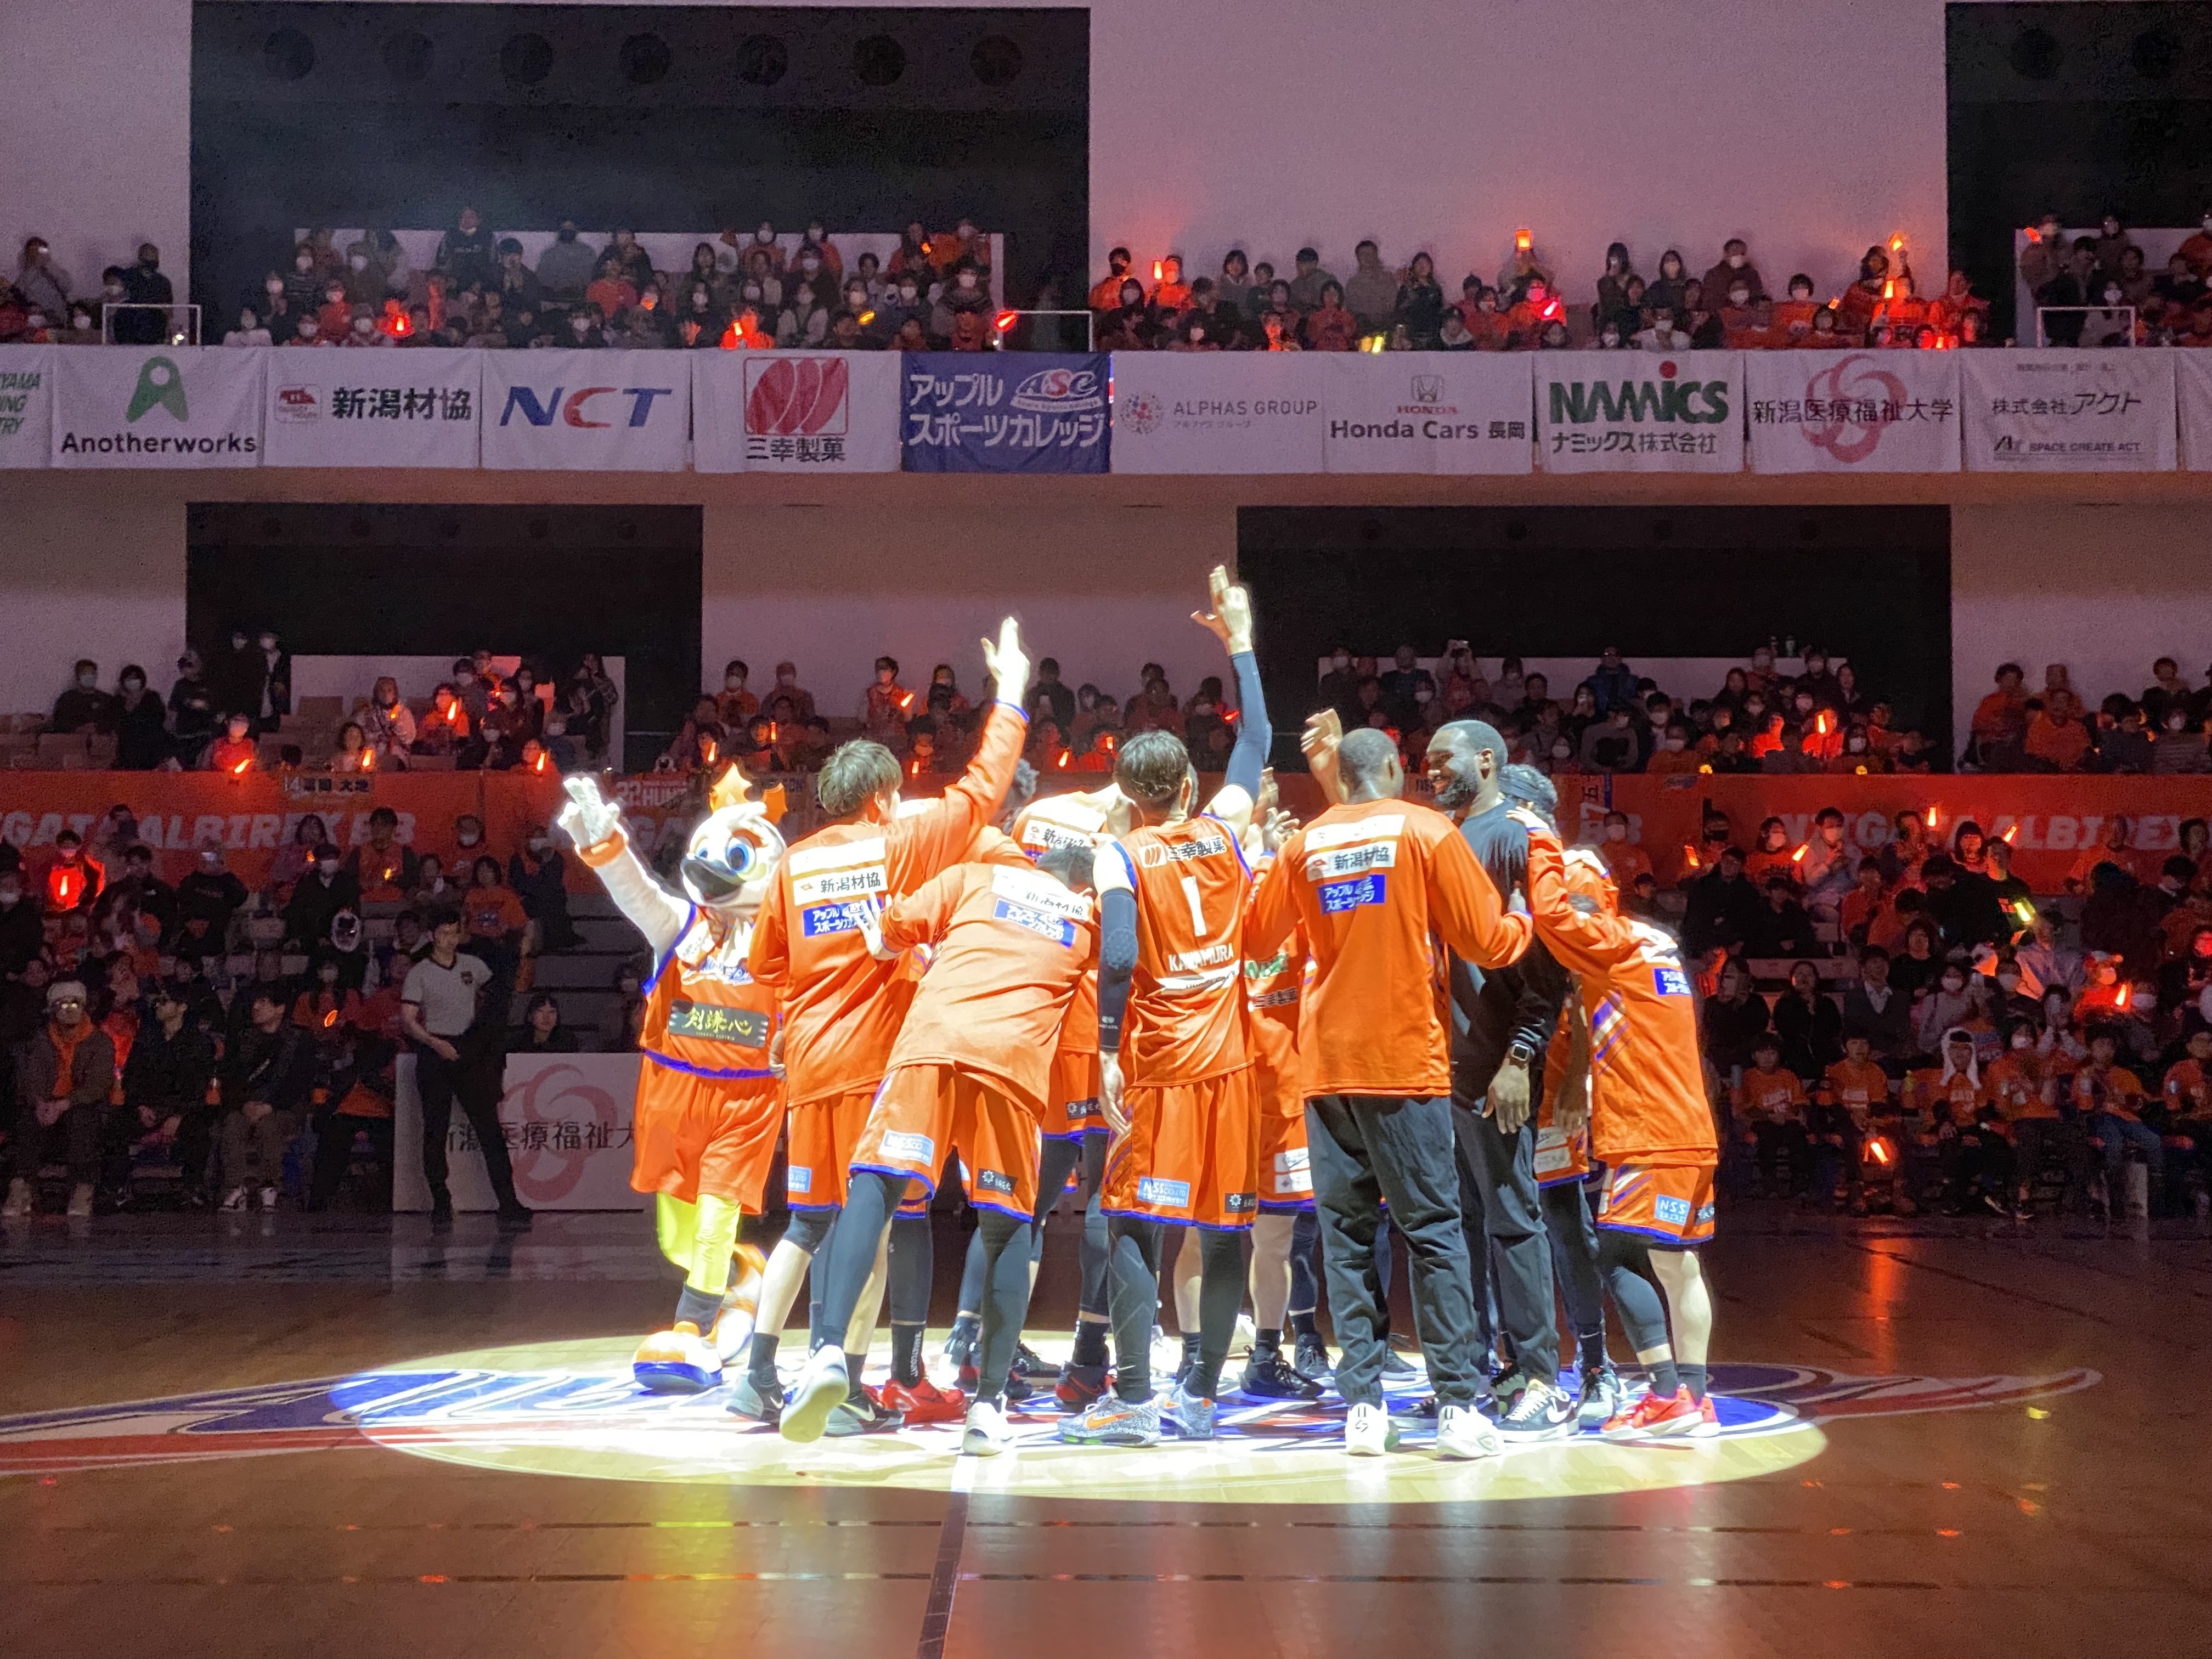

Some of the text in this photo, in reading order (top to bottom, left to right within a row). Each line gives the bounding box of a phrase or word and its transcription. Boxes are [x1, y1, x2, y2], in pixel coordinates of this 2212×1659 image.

[910, 373, 1003, 407] アップル
[332, 386, 472, 421] 新潟材協
[499, 386, 673, 428] NCT
[1173, 400, 1317, 415] ALPHAS GROUP
[1397, 405, 1457, 415] HONDA
[1753, 398, 1954, 424] 新潟医療福祉大学
[1992, 392, 2142, 415] 株式会社アクト
[909, 412, 1105, 447] スポーツカレッジ
[1330, 420, 1526, 439] Honda Cars 長岡
[61, 432, 256, 453] Anotherworks
[746, 438, 846, 463] 三幸製菓
[1552, 431, 1716, 454] ナミックス株式会社
[2029, 442, 2068, 452] SPACE
[2070, 442, 2113, 452] CREATE
[2118, 442, 2141, 452] ACT
[1167, 837, 1226, 860] 三幸製菓
[820, 872, 881, 893] 新潟材協
[812, 906, 840, 922] アップル
[1181, 876, 1207, 936] 1
[1168, 942, 1234, 972] KAWAMURA
[1660, 1199, 1686, 1215] NSS
